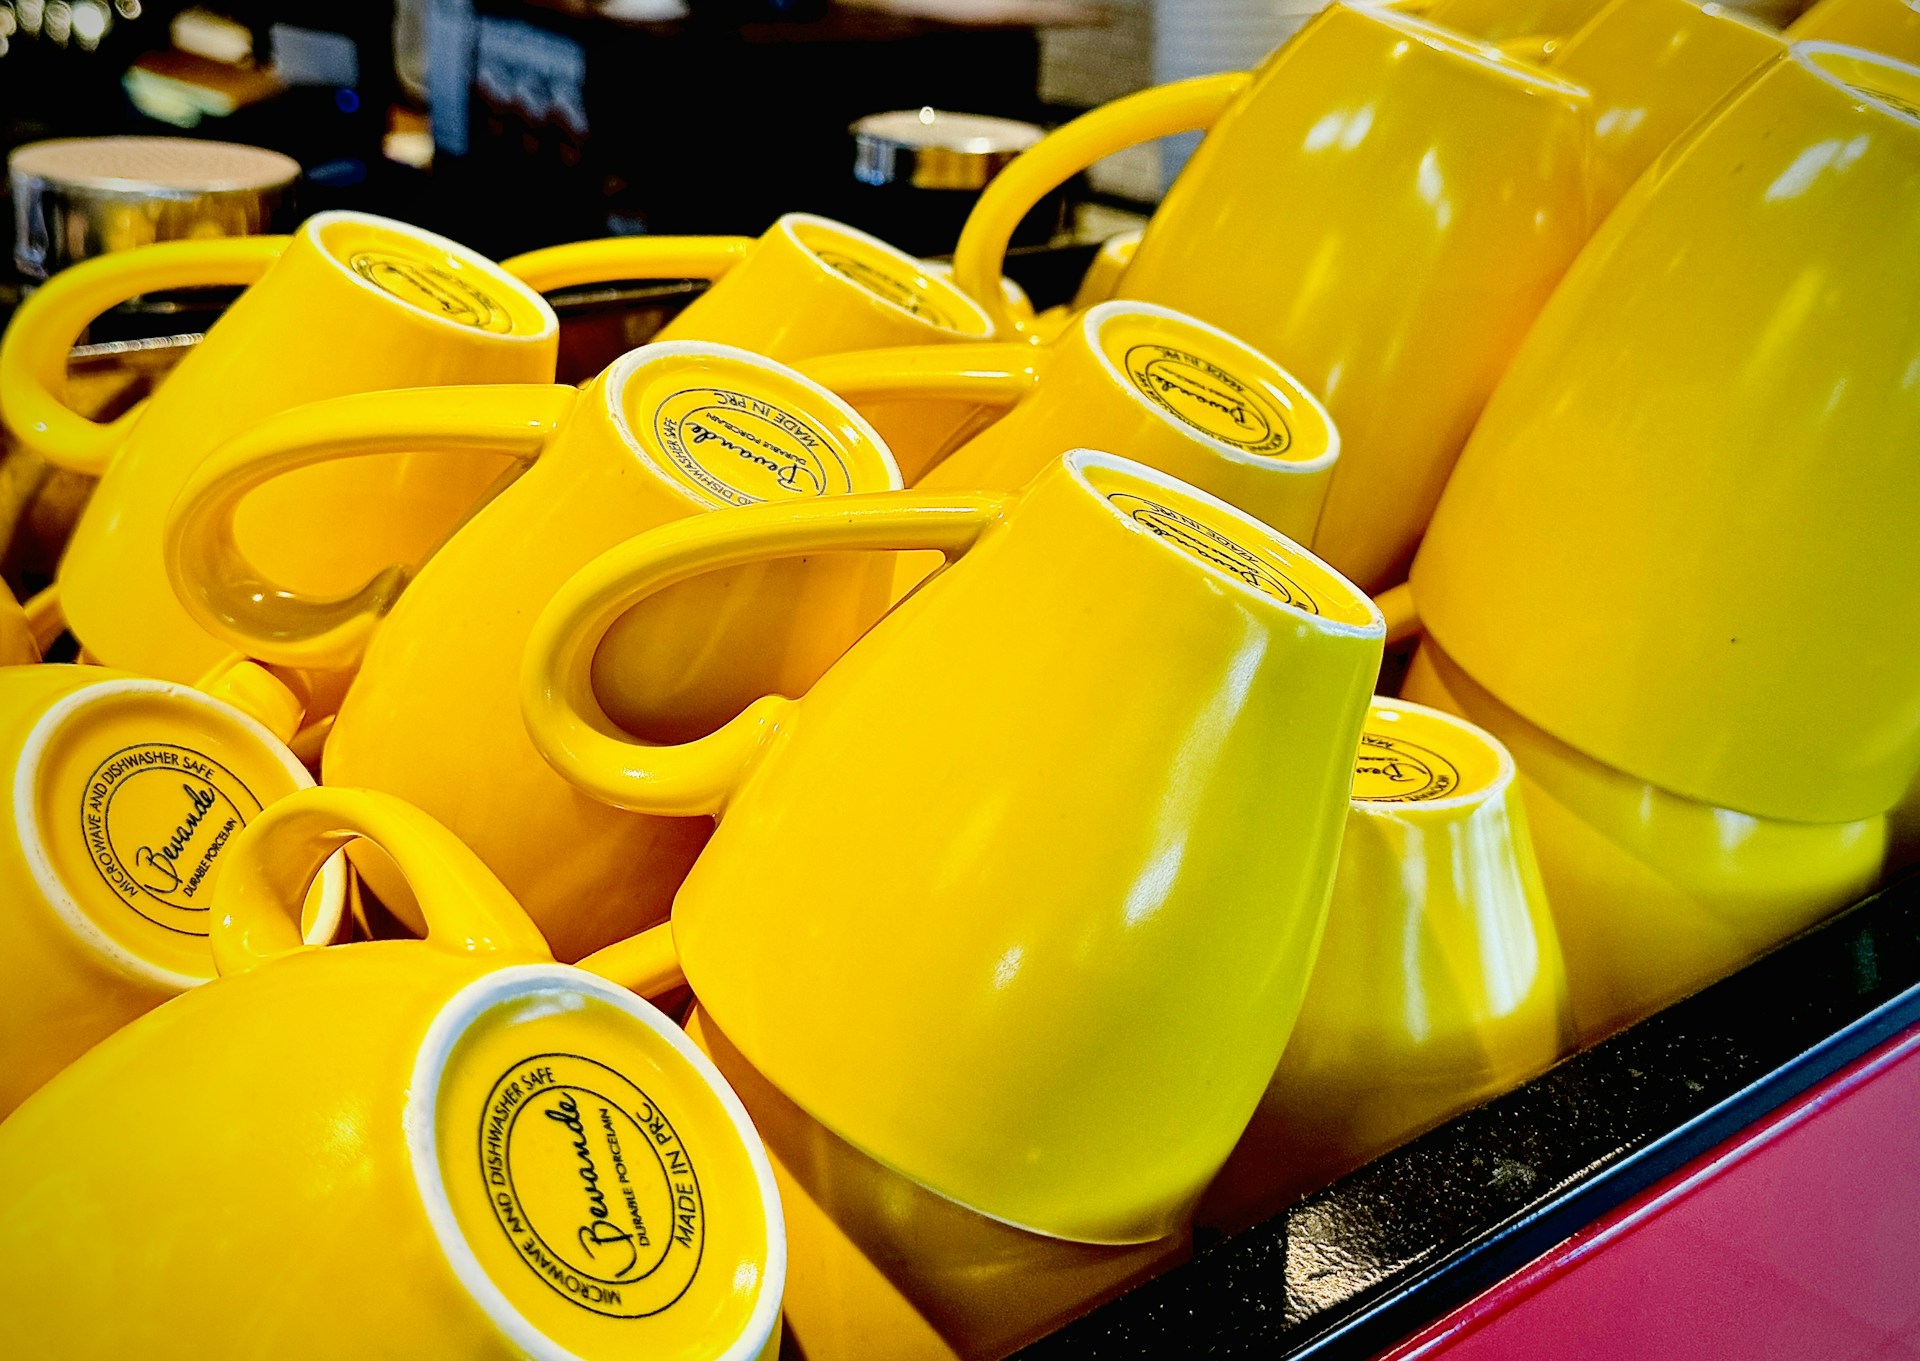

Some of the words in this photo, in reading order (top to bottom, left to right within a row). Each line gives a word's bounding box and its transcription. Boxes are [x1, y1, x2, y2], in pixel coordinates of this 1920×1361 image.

[714, 392, 748, 409] PRC
[751, 402, 771, 417] IN
[663, 416, 678, 440] SAFE
[706, 412, 761, 445] PORCELAIN
[773, 413, 820, 448] MADE
[666, 439, 735, 500] DISHWASHER
[685, 421, 820, 493] Bevande
[763, 440, 807, 466] DURABLE
[1137, 517, 1287, 595] Bevande
[102, 751, 180, 786] DISHWASHER
[182, 756, 216, 781] SAFE
[89, 782, 109, 812] AND
[90, 813, 139, 898] MICROWAVE
[135, 783, 216, 894] Bevande
[183, 857, 212, 898] DURABLE
[204, 817, 238, 863] PORCELAIN
[520, 1066, 557, 1091] SAFE
[486, 1083, 526, 1187] DISHWASHER
[599, 1107, 629, 1184] PORCELAIN
[636, 1101, 672, 1146] PRC
[545, 1091, 638, 1278] Bevande
[666, 1151, 689, 1175] IN
[496, 1191, 525, 1235] AND
[622, 1186, 651, 1247] DURABLE
[673, 1182, 697, 1249] MADE
[521, 1238, 623, 1306] MICROWAVE
